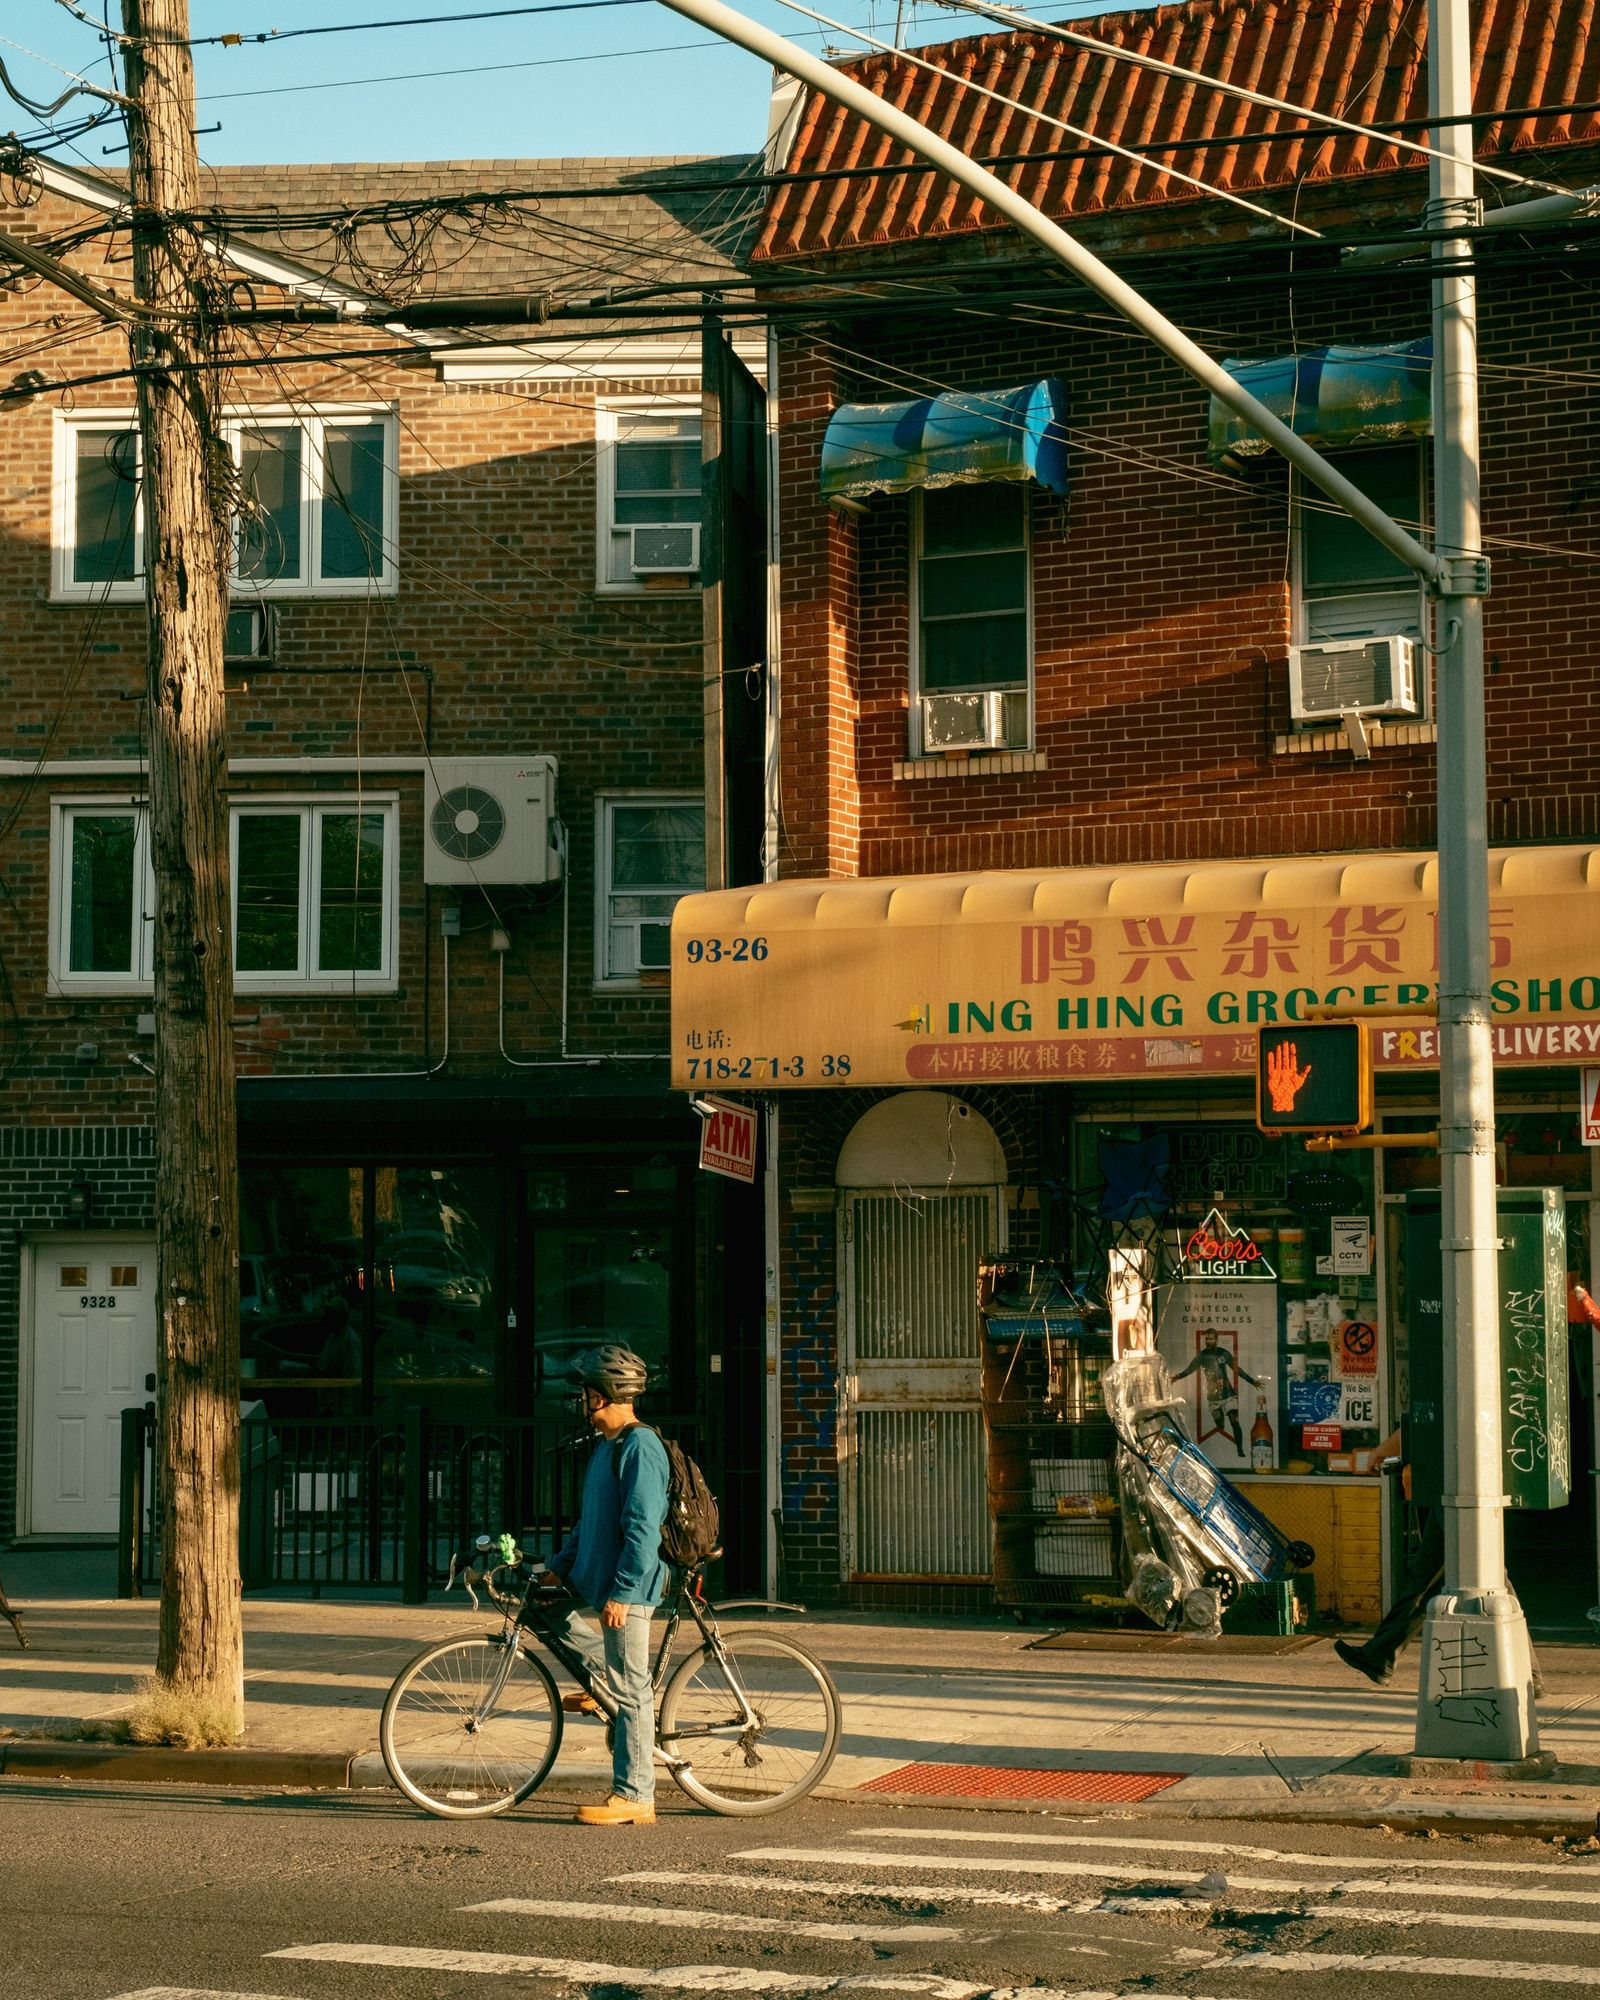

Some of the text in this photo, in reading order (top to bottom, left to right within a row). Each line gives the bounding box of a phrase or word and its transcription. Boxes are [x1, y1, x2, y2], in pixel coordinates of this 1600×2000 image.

[686, 936, 769, 964] 93-26
[911, 1000, 1032, 1034] ING
[1058, 993, 1184, 1030] HING
[1207, 984, 1438, 1025] GROCER
[1382, 1023, 1600, 1060] FRE LIVERY
[705, 1112, 751, 1161] ATM
[1180, 1131, 1263, 1162] BUD
[703, 1152, 753, 1176] AVAILABLE INSIDE
[1335, 1222, 1366, 1230] WARNING
[1186, 1229, 1263, 1261] Coors
[1339, 1252, 1363, 1260] CCTV
[1199, 1260, 1248, 1276] LIGHT
[80, 1296, 117, 1309] 9328
[1219, 1292, 1244, 1300] ULTRA
[1184, 1305, 1250, 1313] UNITED BY
[1182, 1315, 1253, 1324] GREATNESS
[1343, 1354, 1375, 1363] No Pets
[1342, 1364, 1377, 1374] Allowed
[1346, 1383, 1372, 1392] We Sell
[1345, 1399, 1373, 1422] ICE
[1310, 1441, 1333, 1449] INSIDE
